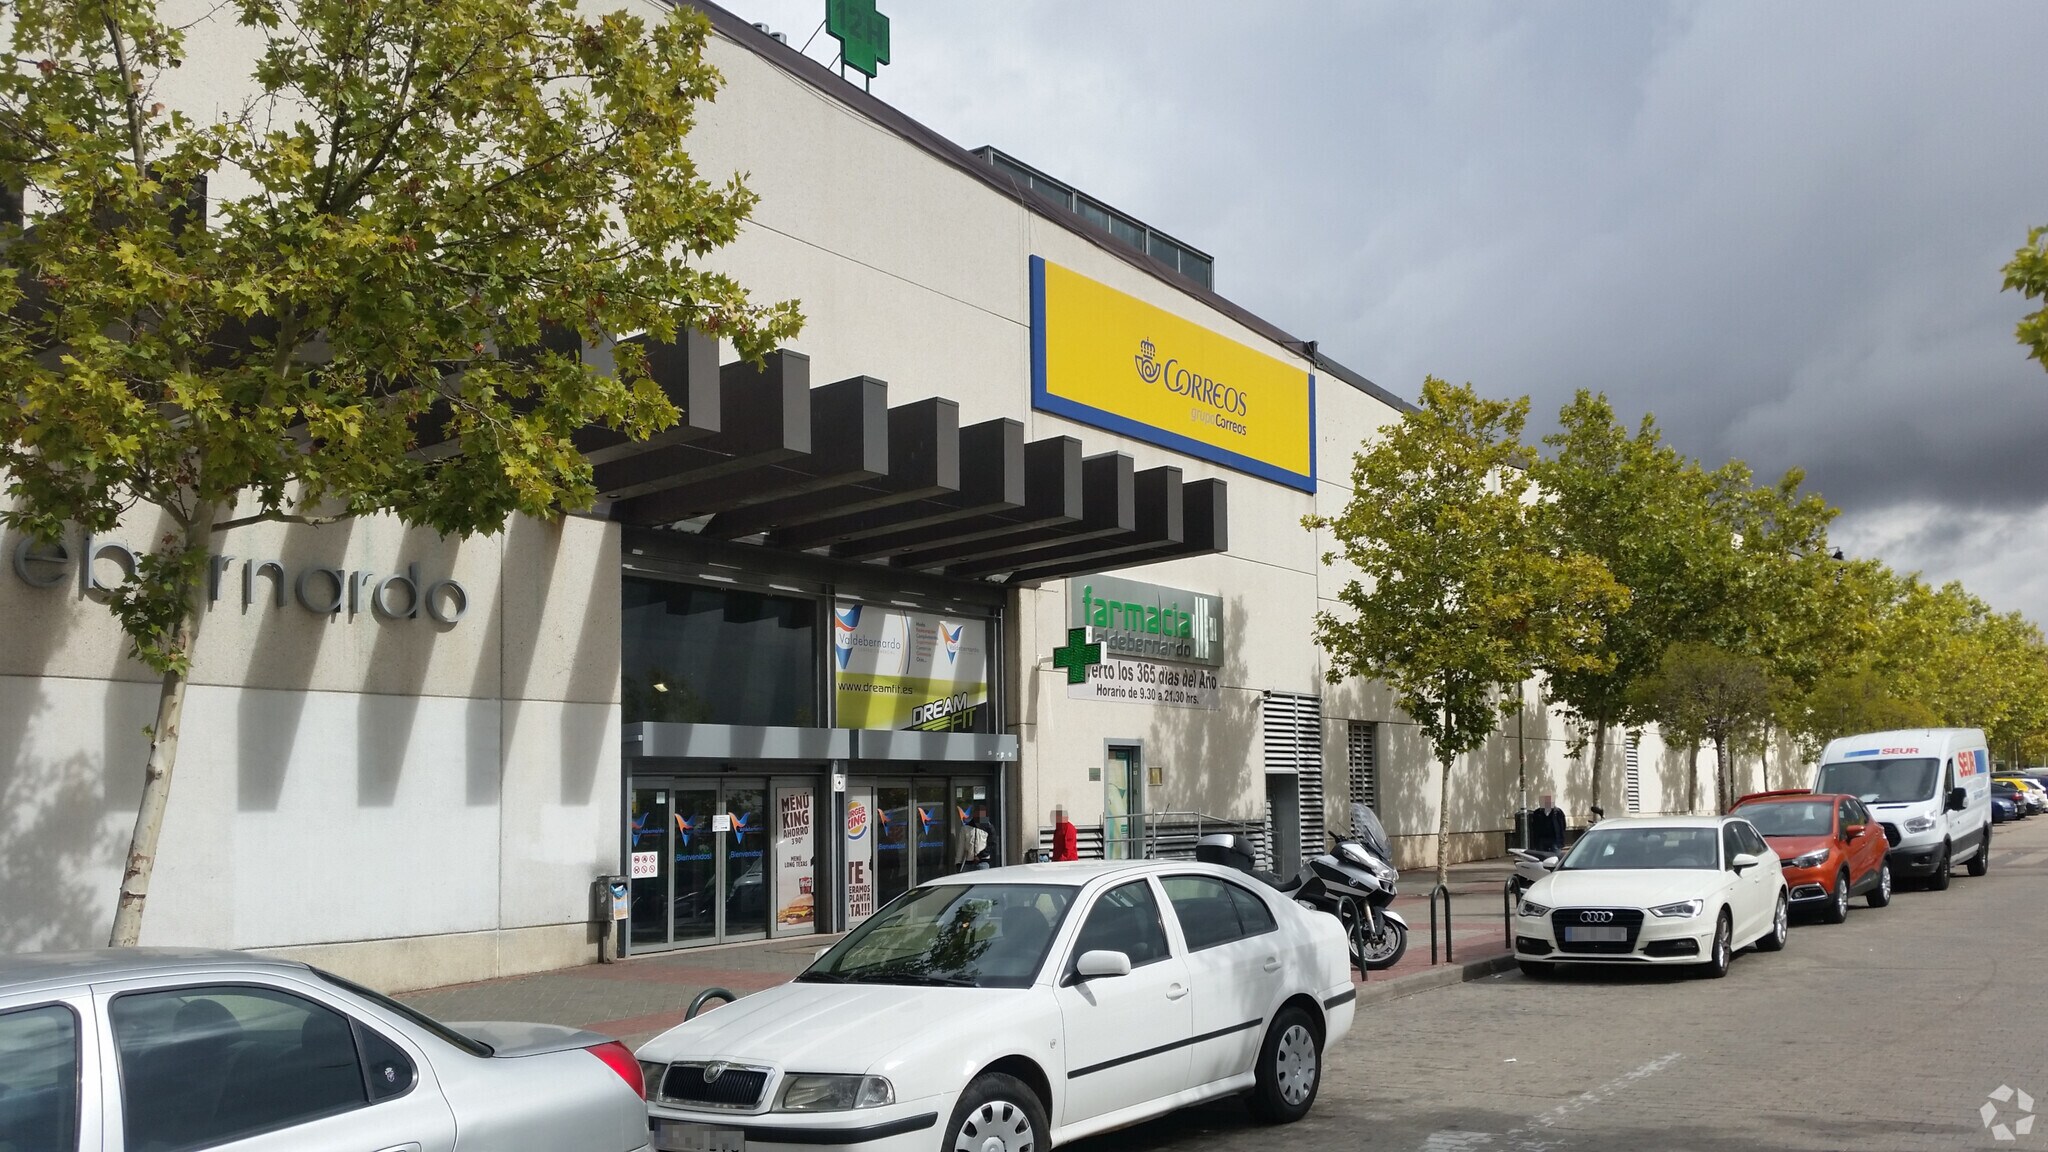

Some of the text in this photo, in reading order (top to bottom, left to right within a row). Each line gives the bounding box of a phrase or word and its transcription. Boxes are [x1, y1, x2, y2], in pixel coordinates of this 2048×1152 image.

[1164, 359, 1247, 417] CORREOS
[14, 530, 469, 623] ebrnardo
[1082, 584, 1191, 639] farmacia
[839, 632, 901, 650] Valdebernardo
[1092, 628, 1191, 657] aldebernardo
[1088, 664, 1115, 680] erto
[1117, 660, 1134, 681] los
[1137, 662, 1155, 684] 365
[1182, 668, 1197, 688] del
[838, 682, 913, 695] www.dreamfit.es
[1096, 683, 1126, 698] Horario
[1128, 686, 1138, 699] de
[1139, 687, 1156, 701] 9.30
[1158, 692, 1163, 701] a
[1164, 690, 1185, 703] 21.30
[912, 692, 967, 726] DREAM
[950, 707, 977, 732] FIT
[1882, 747, 1919, 755] SEUR
[1958, 751, 1976, 778] SEUR
[782, 810, 810, 829] KING
[848, 885, 870, 894] ERAMOS
[848, 903, 870, 917] TA!!!
